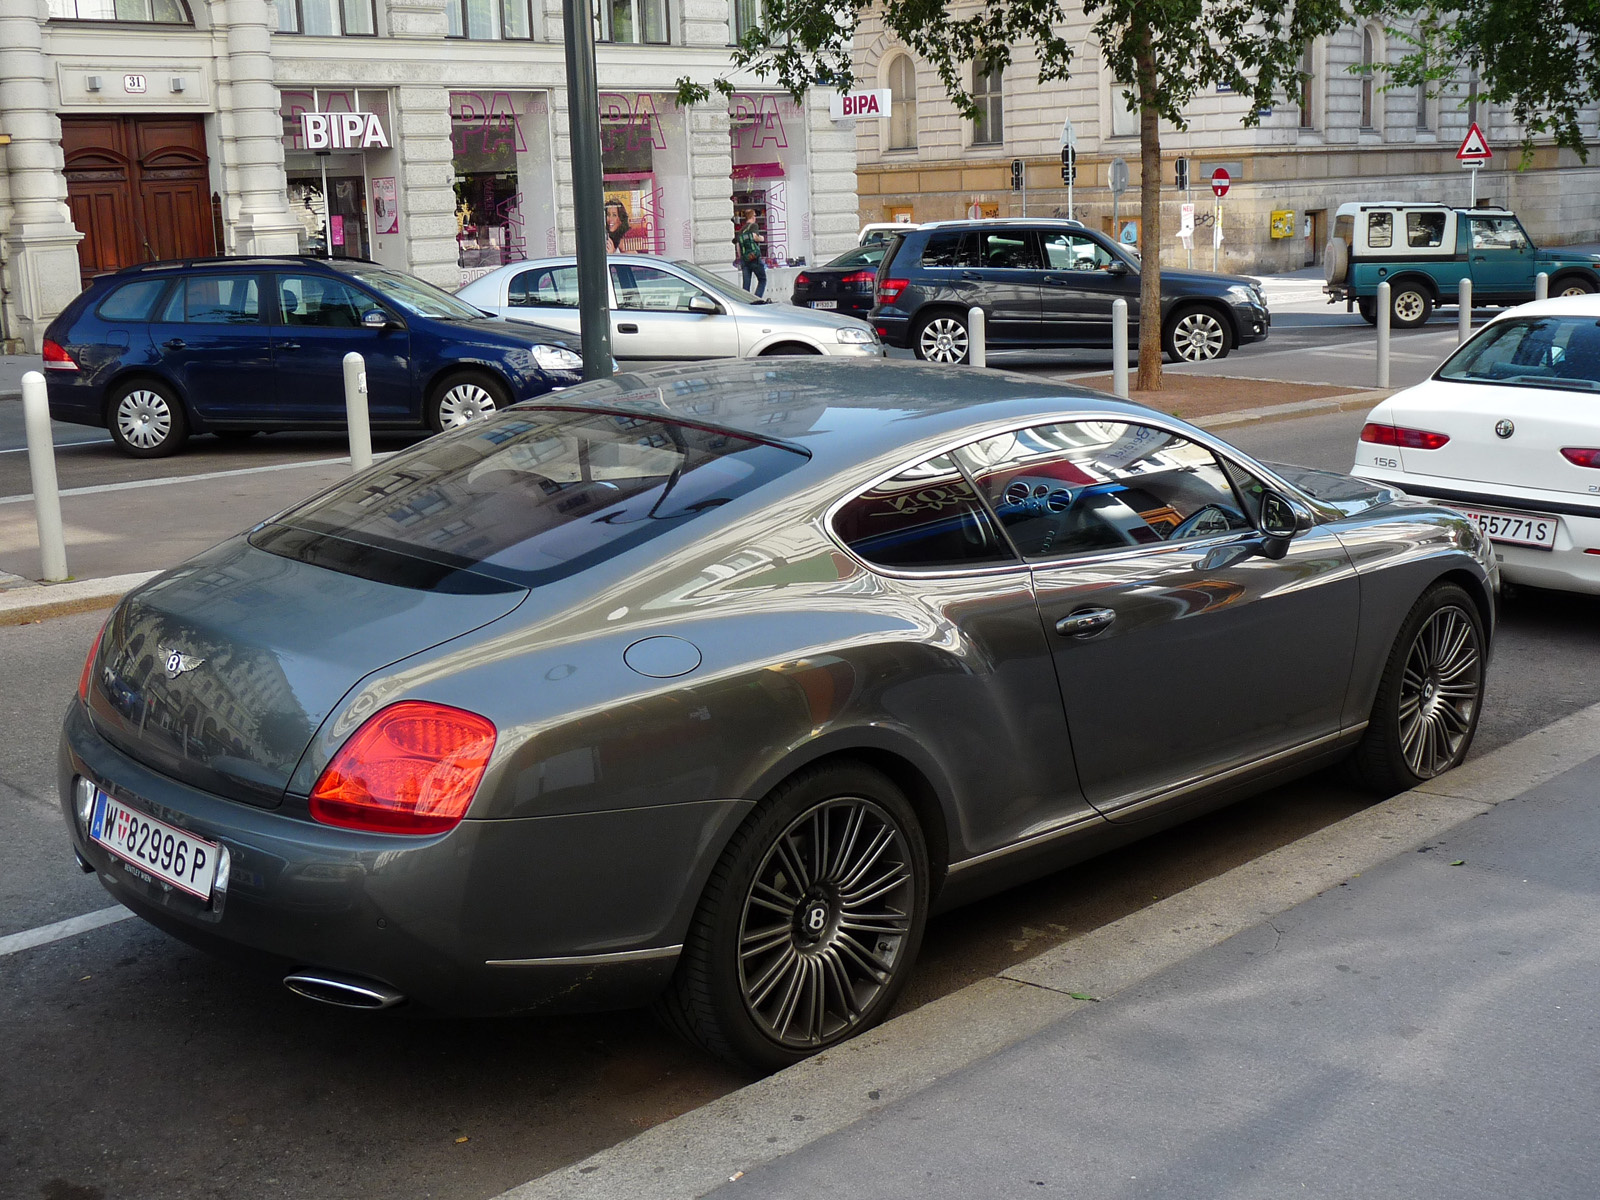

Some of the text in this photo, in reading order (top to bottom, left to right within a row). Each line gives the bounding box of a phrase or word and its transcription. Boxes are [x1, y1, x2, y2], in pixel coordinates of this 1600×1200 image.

[129, 76, 141, 87] 31
[843, 94, 880, 116] BIPA
[305, 114, 389, 149] BIPA
[640, 187, 666, 256] IPA
[764, 182, 789, 267] BIPA
[1374, 456, 1398, 468] 156
[103, 803, 118, 840] W
[809, 908, 825, 929] B
